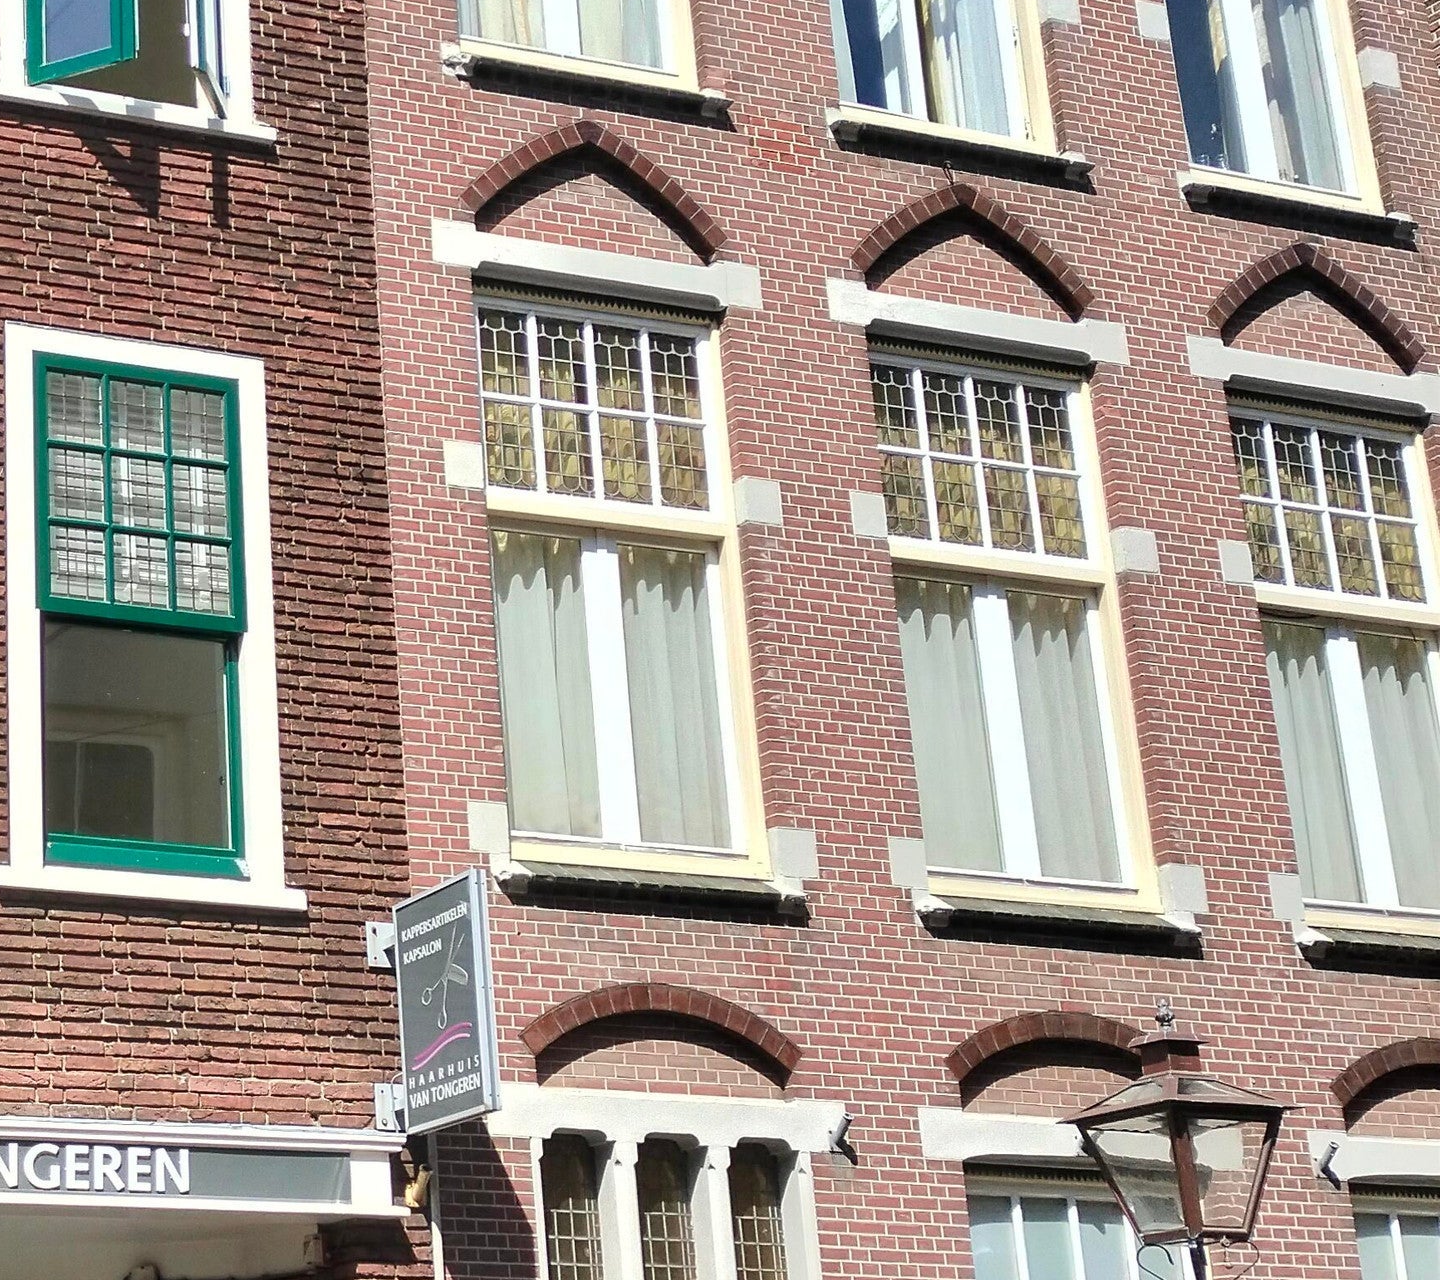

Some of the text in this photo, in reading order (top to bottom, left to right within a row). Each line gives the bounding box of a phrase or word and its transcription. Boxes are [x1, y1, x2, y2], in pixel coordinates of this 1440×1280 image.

[401, 901, 468, 943] KAPPERSARTIKELEN
[403, 938, 442, 965] KAPSALON
[409, 1054, 480, 1090] HAARHUIS
[410, 1072, 481, 1109] VAN TONGEREN
